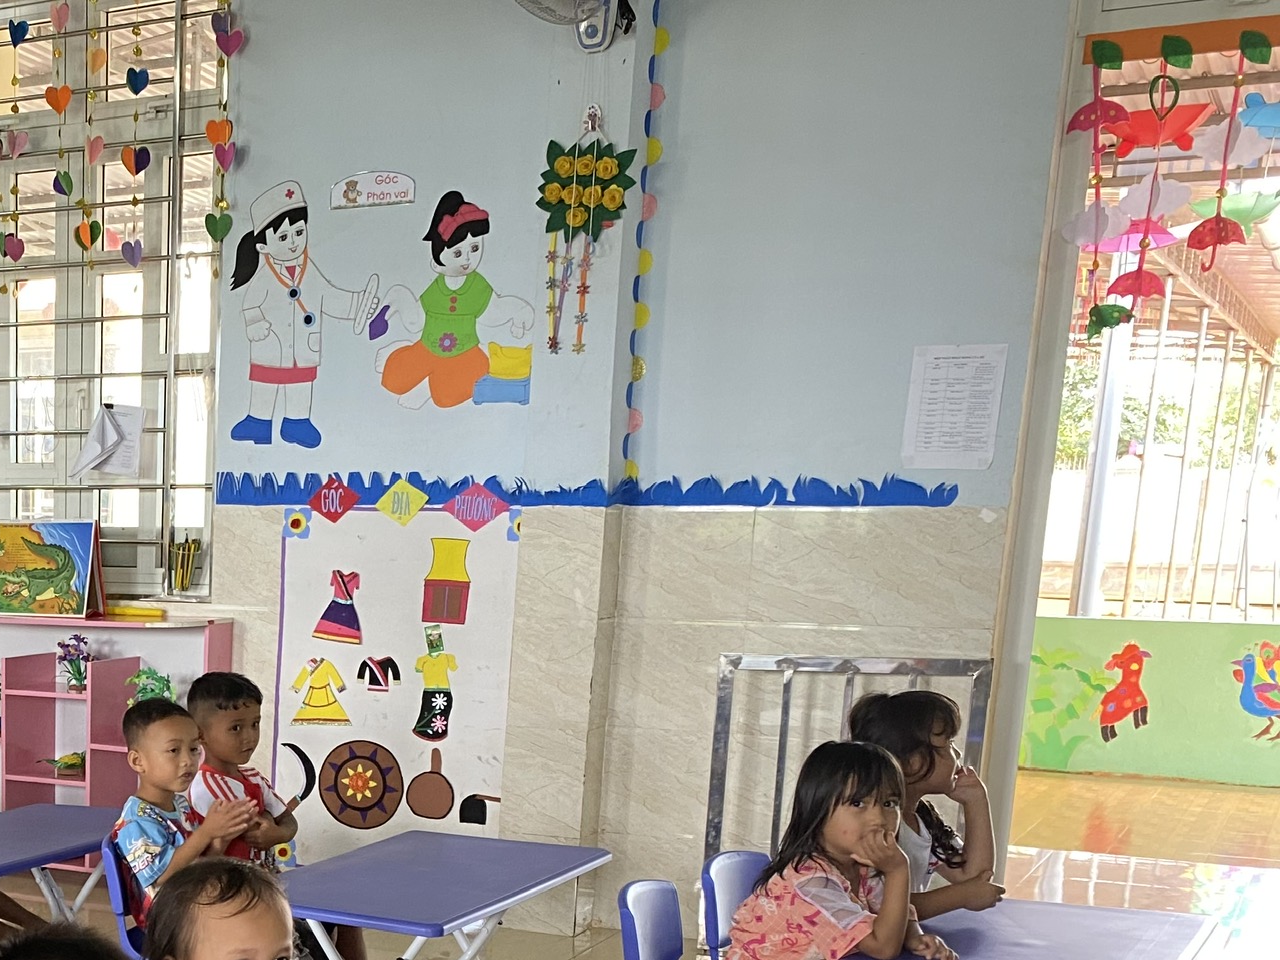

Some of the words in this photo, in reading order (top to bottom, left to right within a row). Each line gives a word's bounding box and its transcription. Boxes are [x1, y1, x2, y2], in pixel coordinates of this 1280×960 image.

[374, 174, 399, 185] Góc
[366, 191, 392, 202] Phân
[394, 188, 409, 199] vai
[321, 482, 345, 513] GÓC
